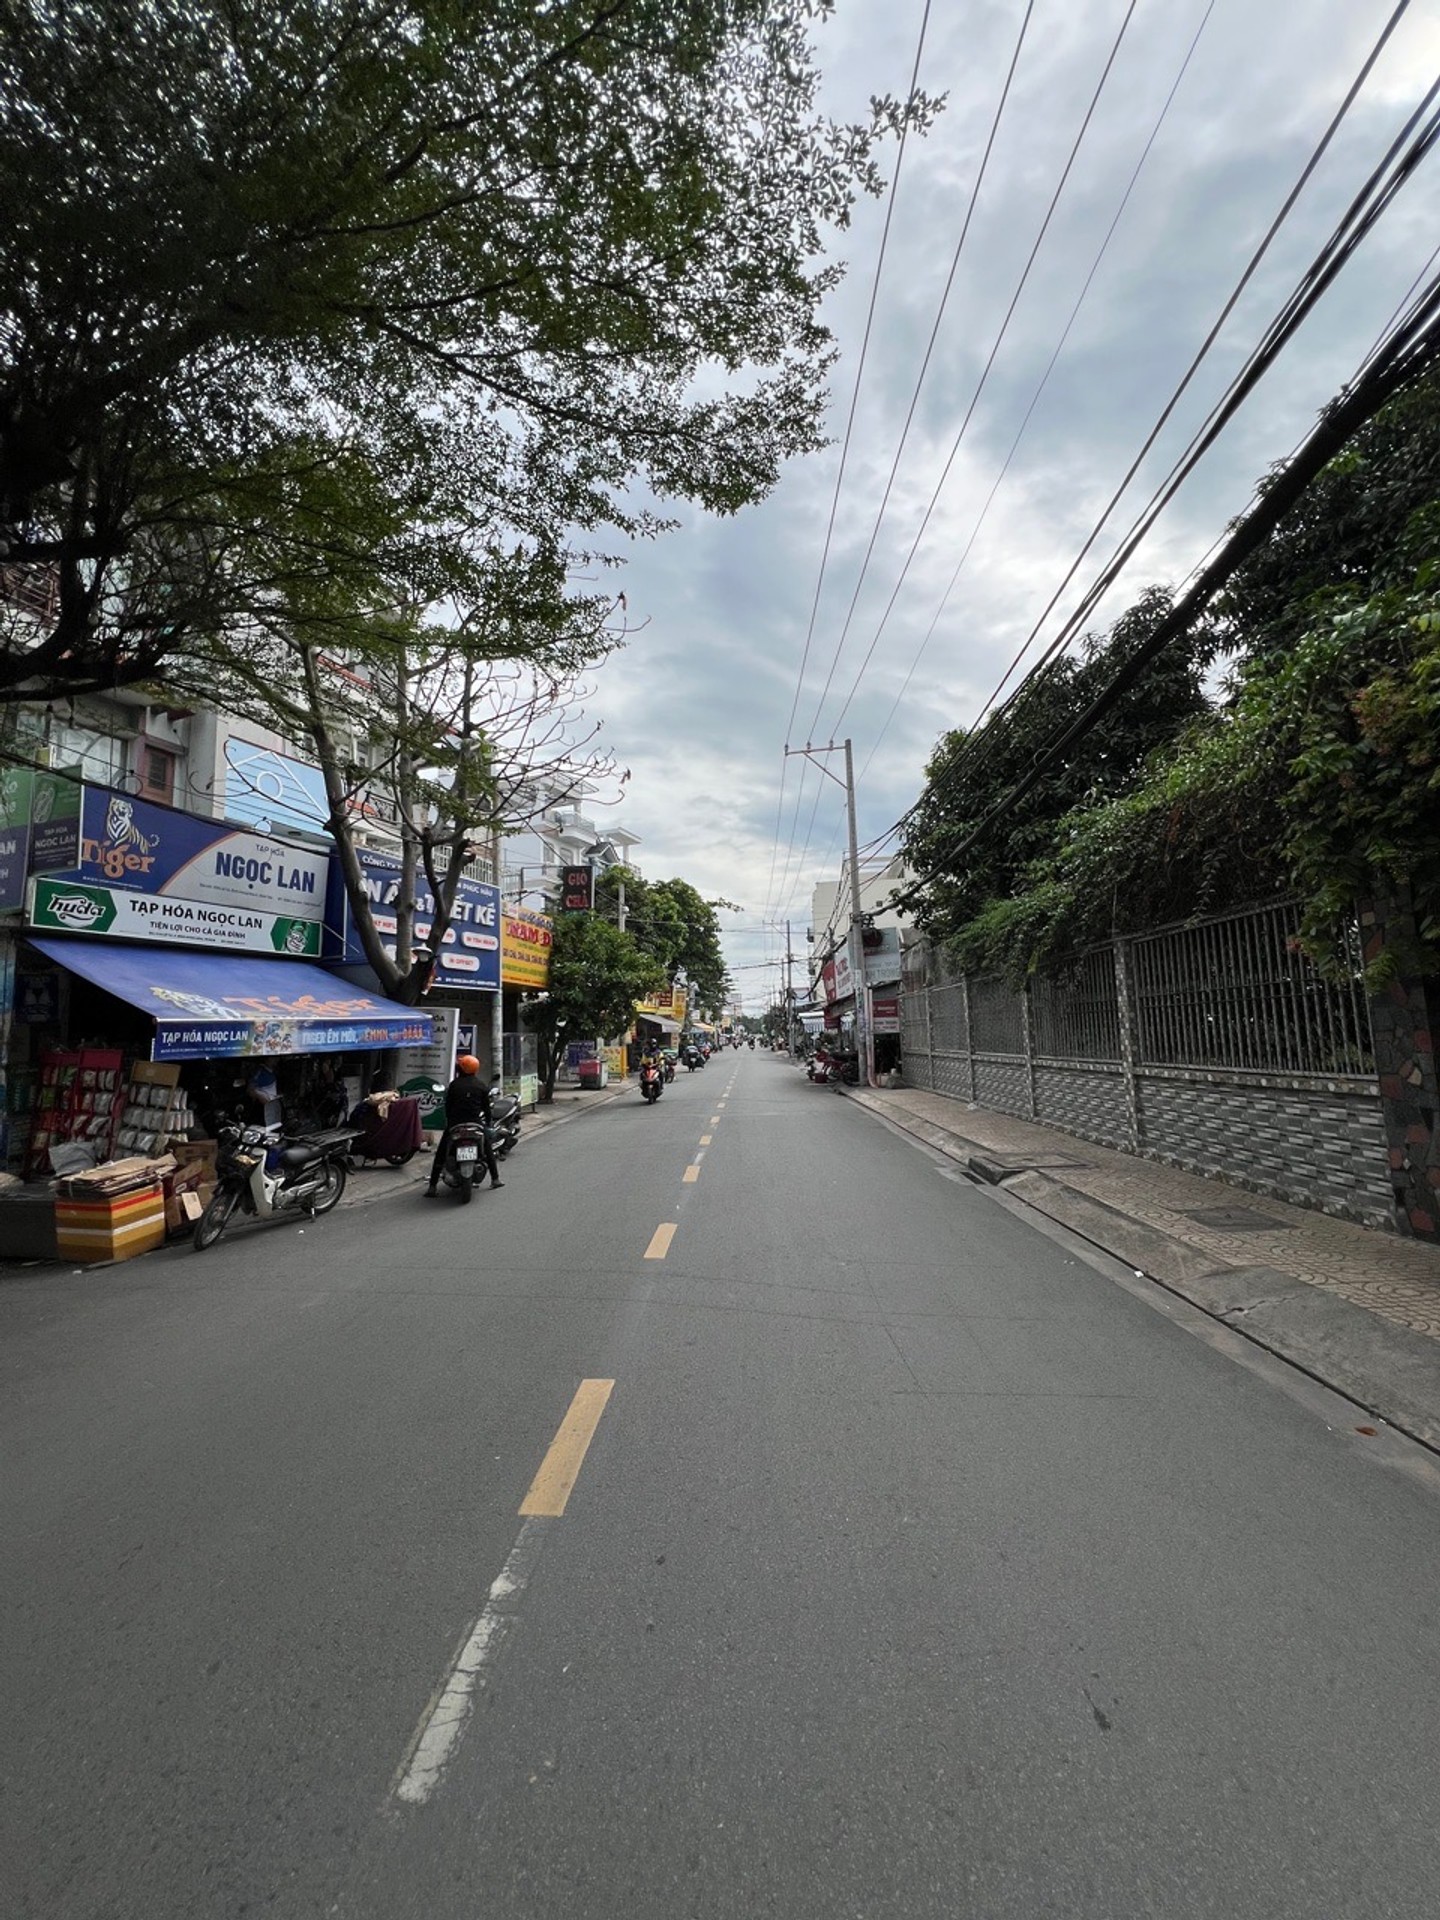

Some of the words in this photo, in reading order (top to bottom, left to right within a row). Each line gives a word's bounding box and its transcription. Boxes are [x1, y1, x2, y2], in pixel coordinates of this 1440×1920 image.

[0, 840, 16, 855] AN
[59, 834, 76, 845] LAN
[215, 851, 273, 890] NGỌC
[277, 865, 315, 893] LAN
[48, 896, 105, 917] huda
[383, 877, 402, 905] Ấ
[416, 898, 425, 912] &
[424, 893, 474, 921] TẾT
[475, 902, 496, 927] KẾ
[129, 899, 159, 917] TẠP
[162, 904, 194, 920] HÓA
[197, 910, 235, 928] NGỌC
[238, 915, 263, 930] LAN
[184, 925, 201, 934] CHO
[214, 928, 226, 937] GIA
[162, 1031, 181, 1046] TẠP
[183, 1029, 202, 1043] HÓA
[204, 1031, 229, 1045] NGỌC
[230, 1030, 249, 1041] LAN
